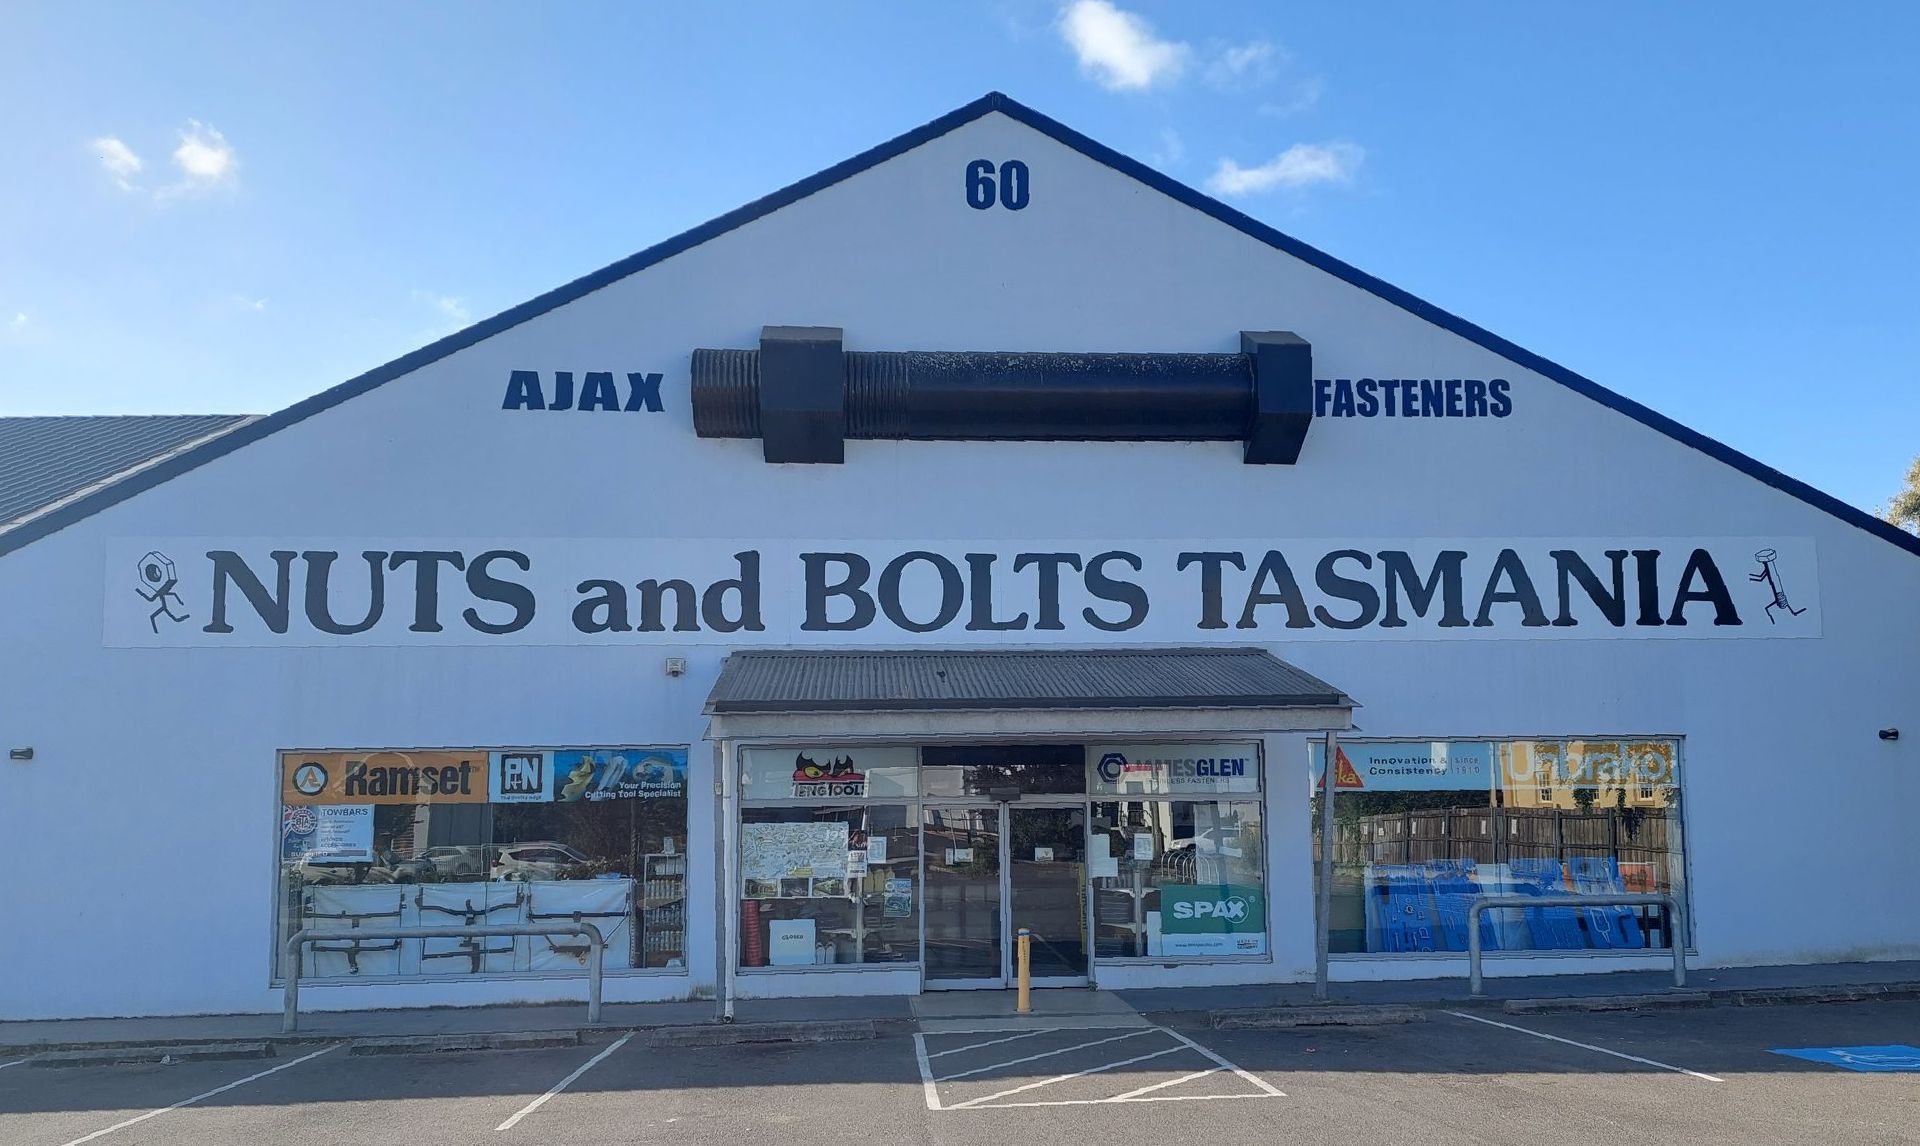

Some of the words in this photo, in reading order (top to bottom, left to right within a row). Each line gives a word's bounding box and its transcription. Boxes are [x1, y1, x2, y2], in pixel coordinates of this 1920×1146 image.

[965, 159, 1029, 210] 60
[502, 370, 665, 412] AJAX
[1314, 378, 1512, 418] FASTENERS
[203, 550, 536, 634] NUTS
[571, 550, 766, 632] and
[800, 551, 1149, 633] BOLTS
[1177, 548, 1743, 629] TASMANIA
[1369, 757, 1435, 765] Innovation
[1369, 766, 1448, 775] Consistency
[1455, 766, 1480, 774] 1910
[345, 760, 471, 796] Ramset
[1187, 776, 1230, 785] FASTENRS
[641, 781, 681, 789] Precision
[638, 790, 681, 799] Specialist
[321, 808, 368, 816] TOWBARS
[1173, 901, 1245, 919] SPAX
